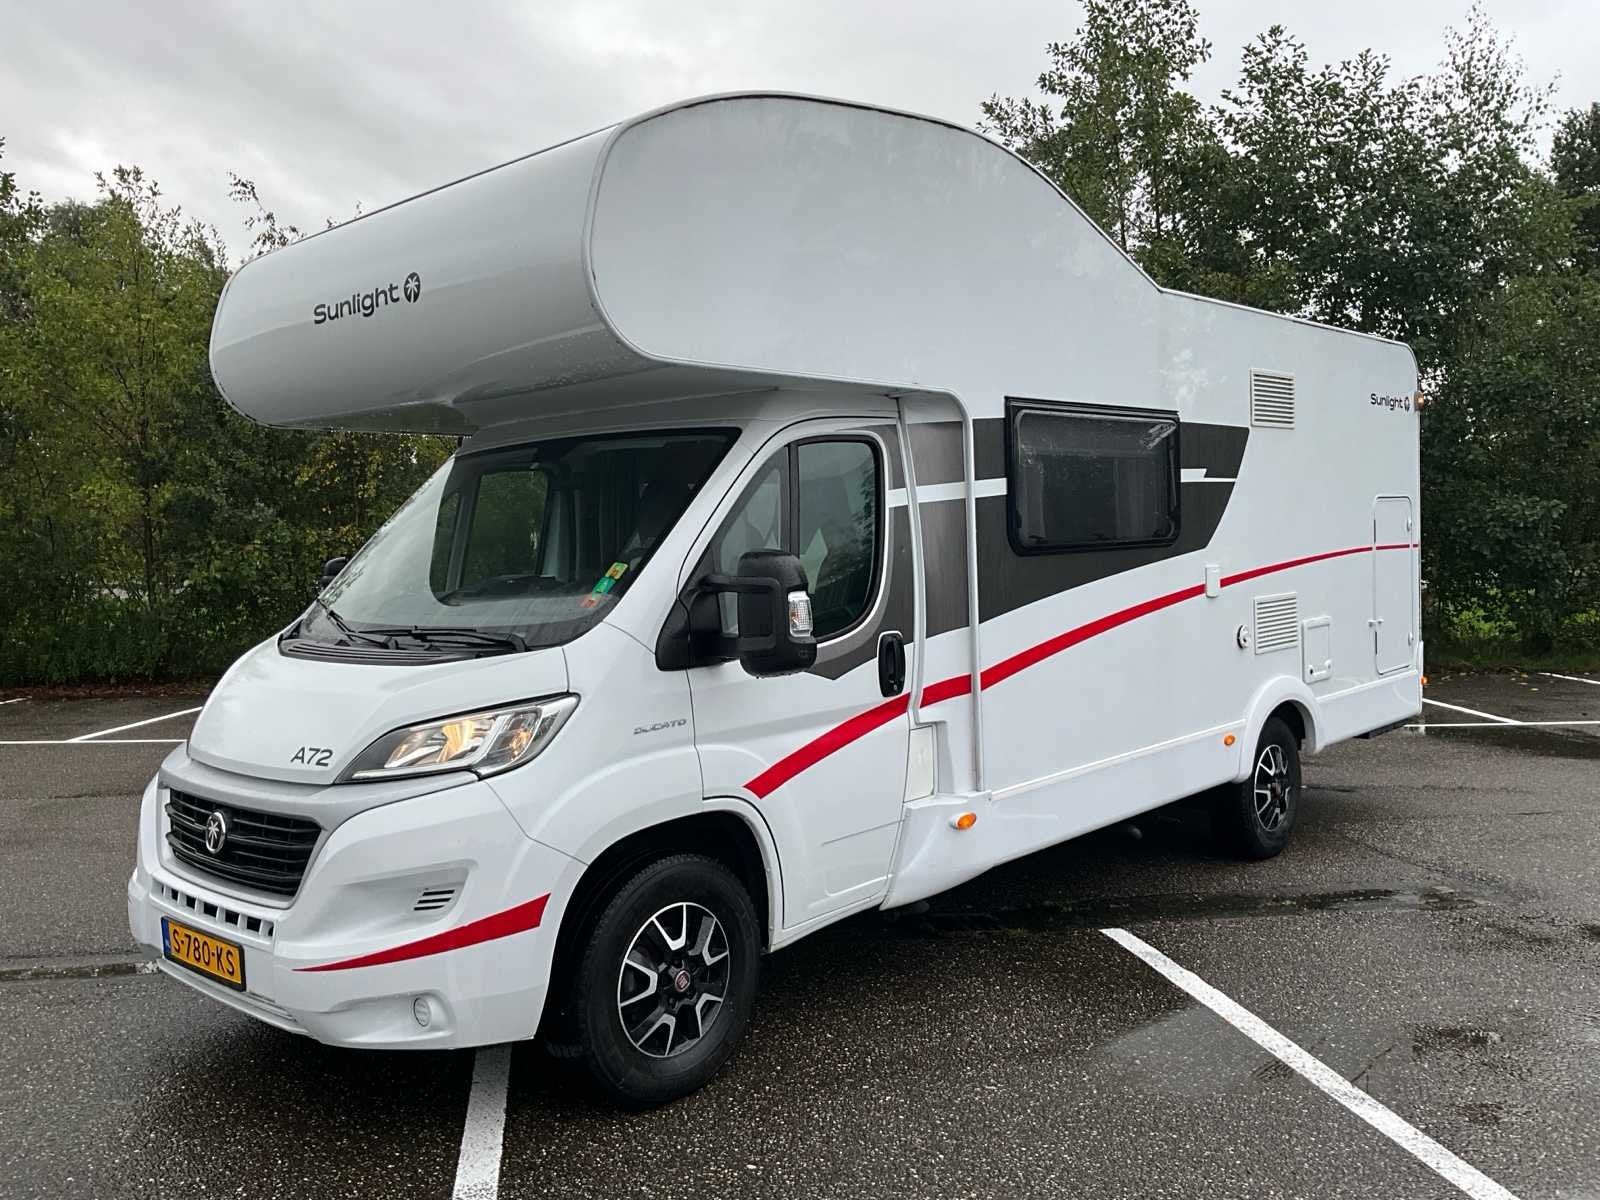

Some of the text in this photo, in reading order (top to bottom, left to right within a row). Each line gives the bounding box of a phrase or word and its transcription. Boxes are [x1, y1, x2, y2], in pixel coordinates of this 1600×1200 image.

[313, 283, 400, 325] Sunlight
[1370, 393, 1403, 411] Sunlight
[290, 746, 333, 767] A72
[172, 928, 235, 977] S-780-KS
